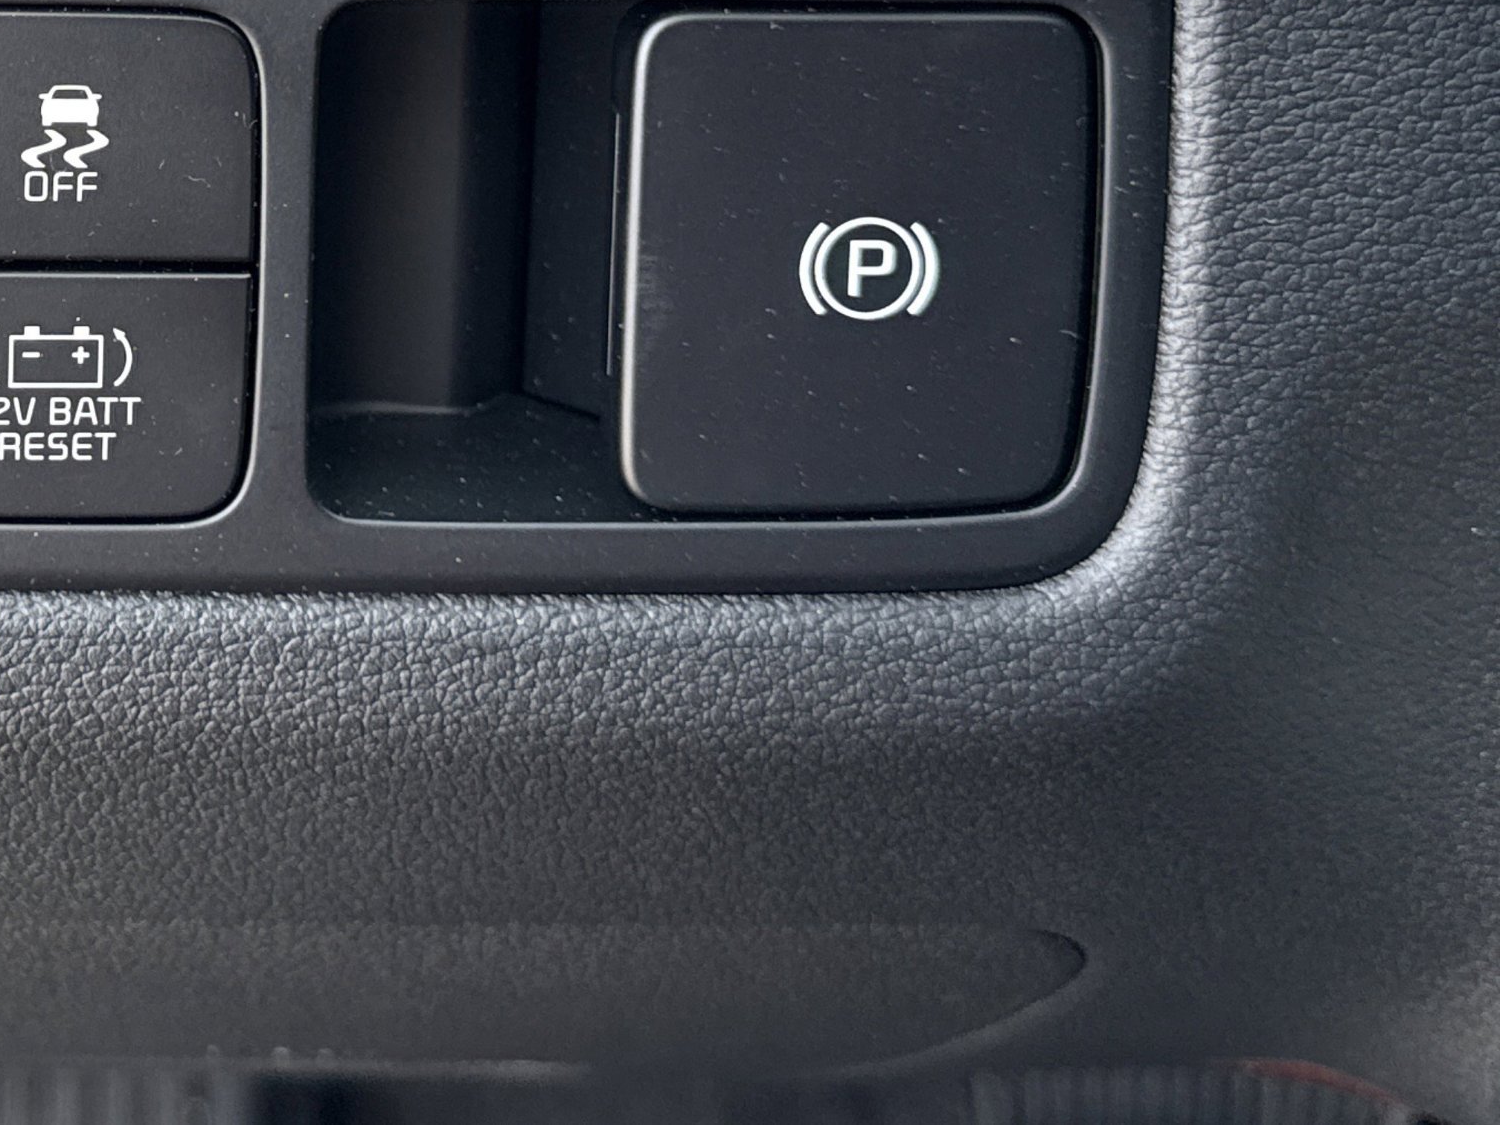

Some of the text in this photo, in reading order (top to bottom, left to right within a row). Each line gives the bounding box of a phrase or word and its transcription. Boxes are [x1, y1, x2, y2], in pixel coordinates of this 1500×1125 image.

[23, 170, 99, 203] OFF
[847, 239, 897, 298] P
[48, 396, 142, 426] BATT
